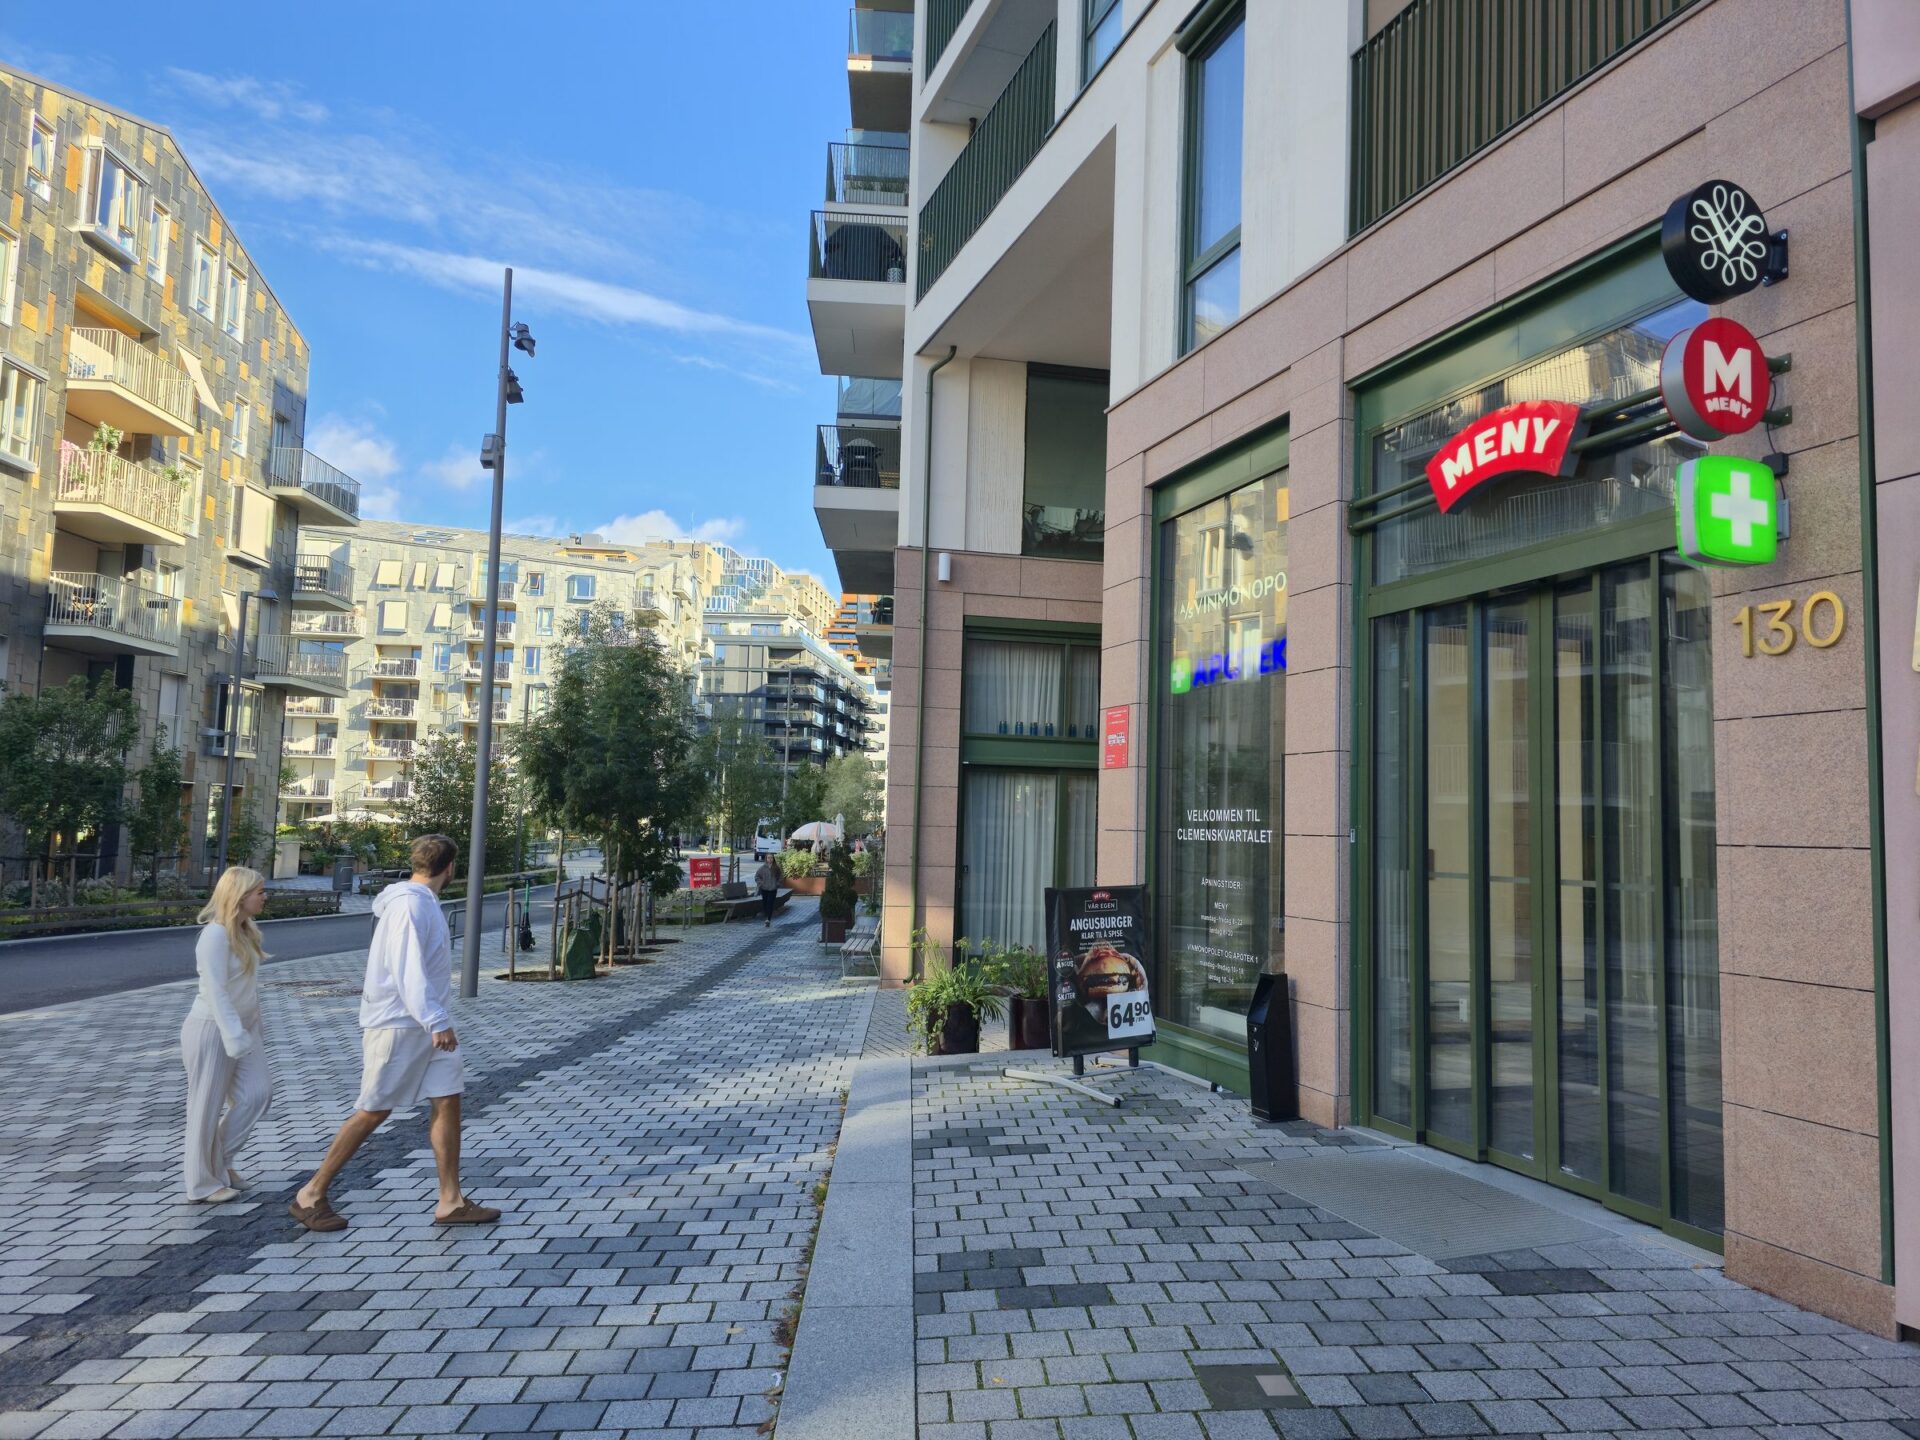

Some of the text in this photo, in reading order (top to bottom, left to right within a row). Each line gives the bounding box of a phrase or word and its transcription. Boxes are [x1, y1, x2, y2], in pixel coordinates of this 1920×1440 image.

[1703, 339, 1752, 404] M
[1705, 396, 1751, 419] MENY
[1440, 416, 1560, 490] MENY
[1180, 603, 1194, 619] A/S
[1732, 590, 1848, 657] 130
[1187, 809, 1261, 822] VELKOMMEN TIL
[1177, 828, 1273, 843] CLEMENSKVARTALET
[1214, 901, 1229, 910] MENY
[1070, 915, 1133, 931] ANGUSBURGER
[1108, 930, 1123, 938] SPISE
[1187, 944, 1223, 957] VINMONOPOLET
[1225, 951, 1232, 959] OG
[1233, 953, 1254, 963] APOTEK
